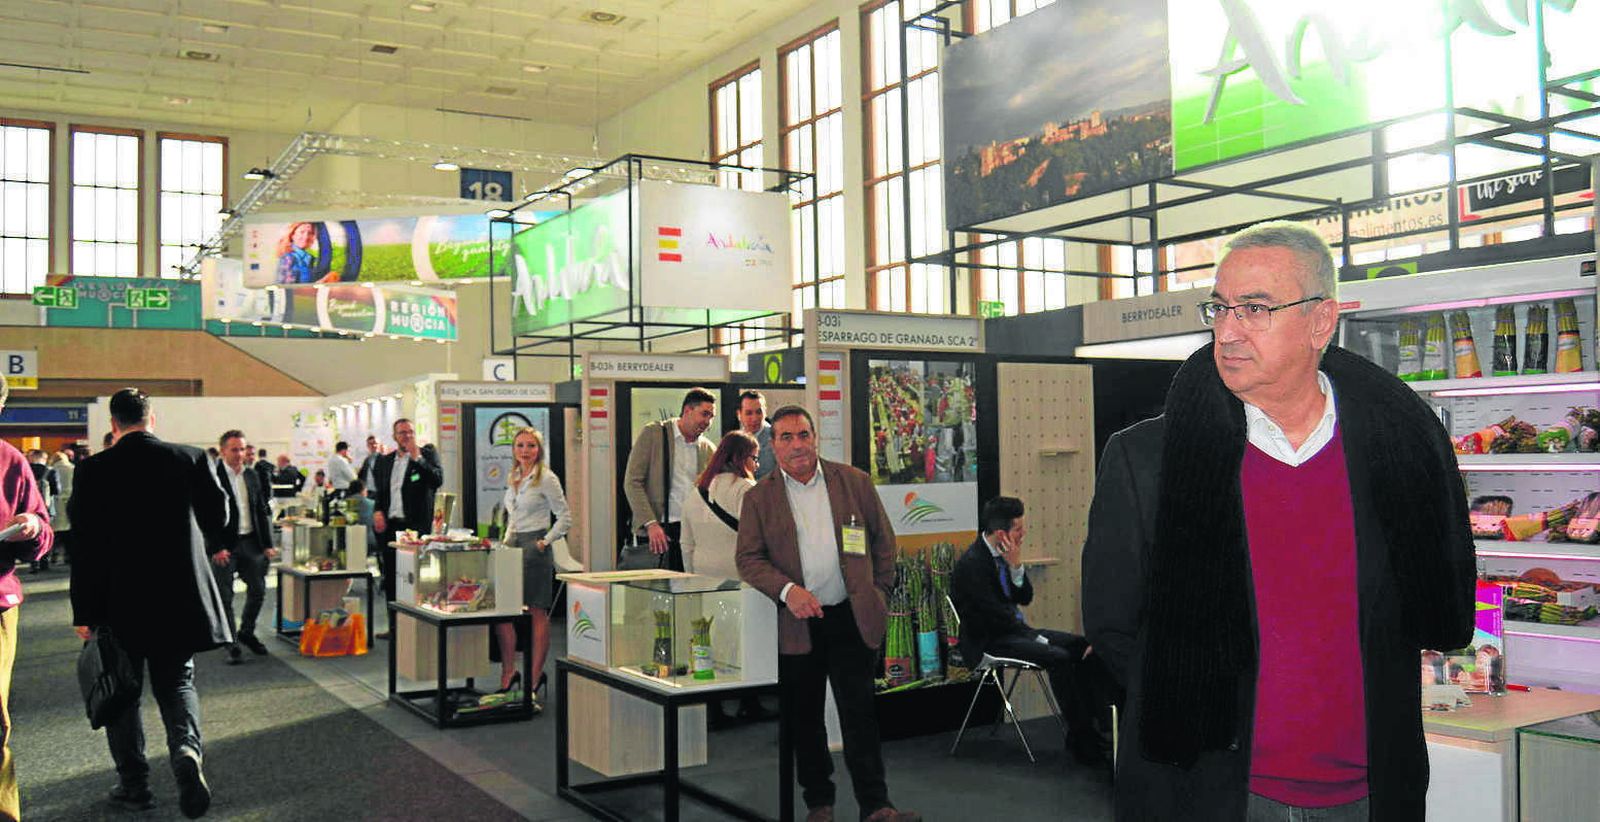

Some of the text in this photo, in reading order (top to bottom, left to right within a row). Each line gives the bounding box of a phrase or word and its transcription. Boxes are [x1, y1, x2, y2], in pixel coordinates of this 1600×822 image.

[468, 181, 503, 201] 18
[1121, 304, 1182, 324] BERRYDEALER
[818, 331, 878, 344] ESPARRAGO
[881, 333, 893, 344] DE
[896, 333, 945, 345] GRANADA
[948, 336, 967, 346] SCA
[9, 355, 24, 374] B
[493, 363, 506, 381] C
[617, 362, 674, 371] BERRYDEALER
